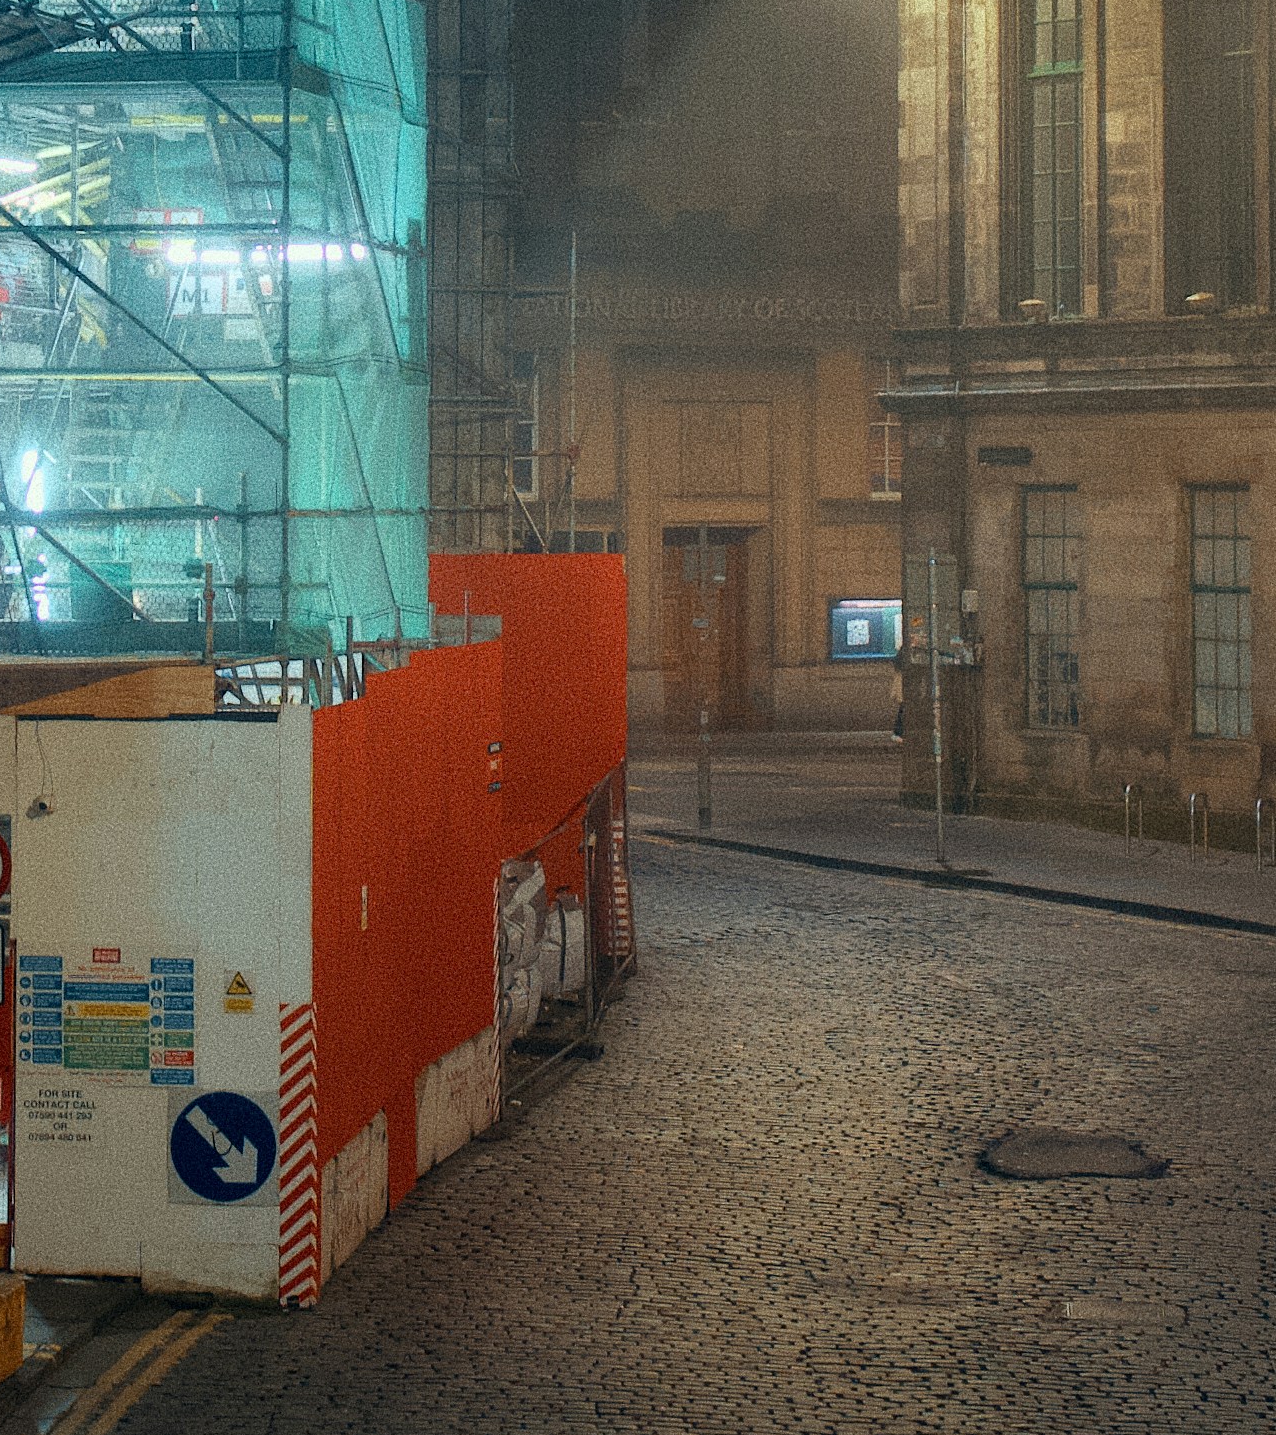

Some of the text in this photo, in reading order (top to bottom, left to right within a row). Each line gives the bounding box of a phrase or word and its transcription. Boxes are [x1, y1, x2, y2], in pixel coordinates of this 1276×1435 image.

[38, 1089, 83, 1098] FOR SITE
[23, 1100, 96, 1109] CONTACT CALL
[52, 1122, 67, 1131] OR
